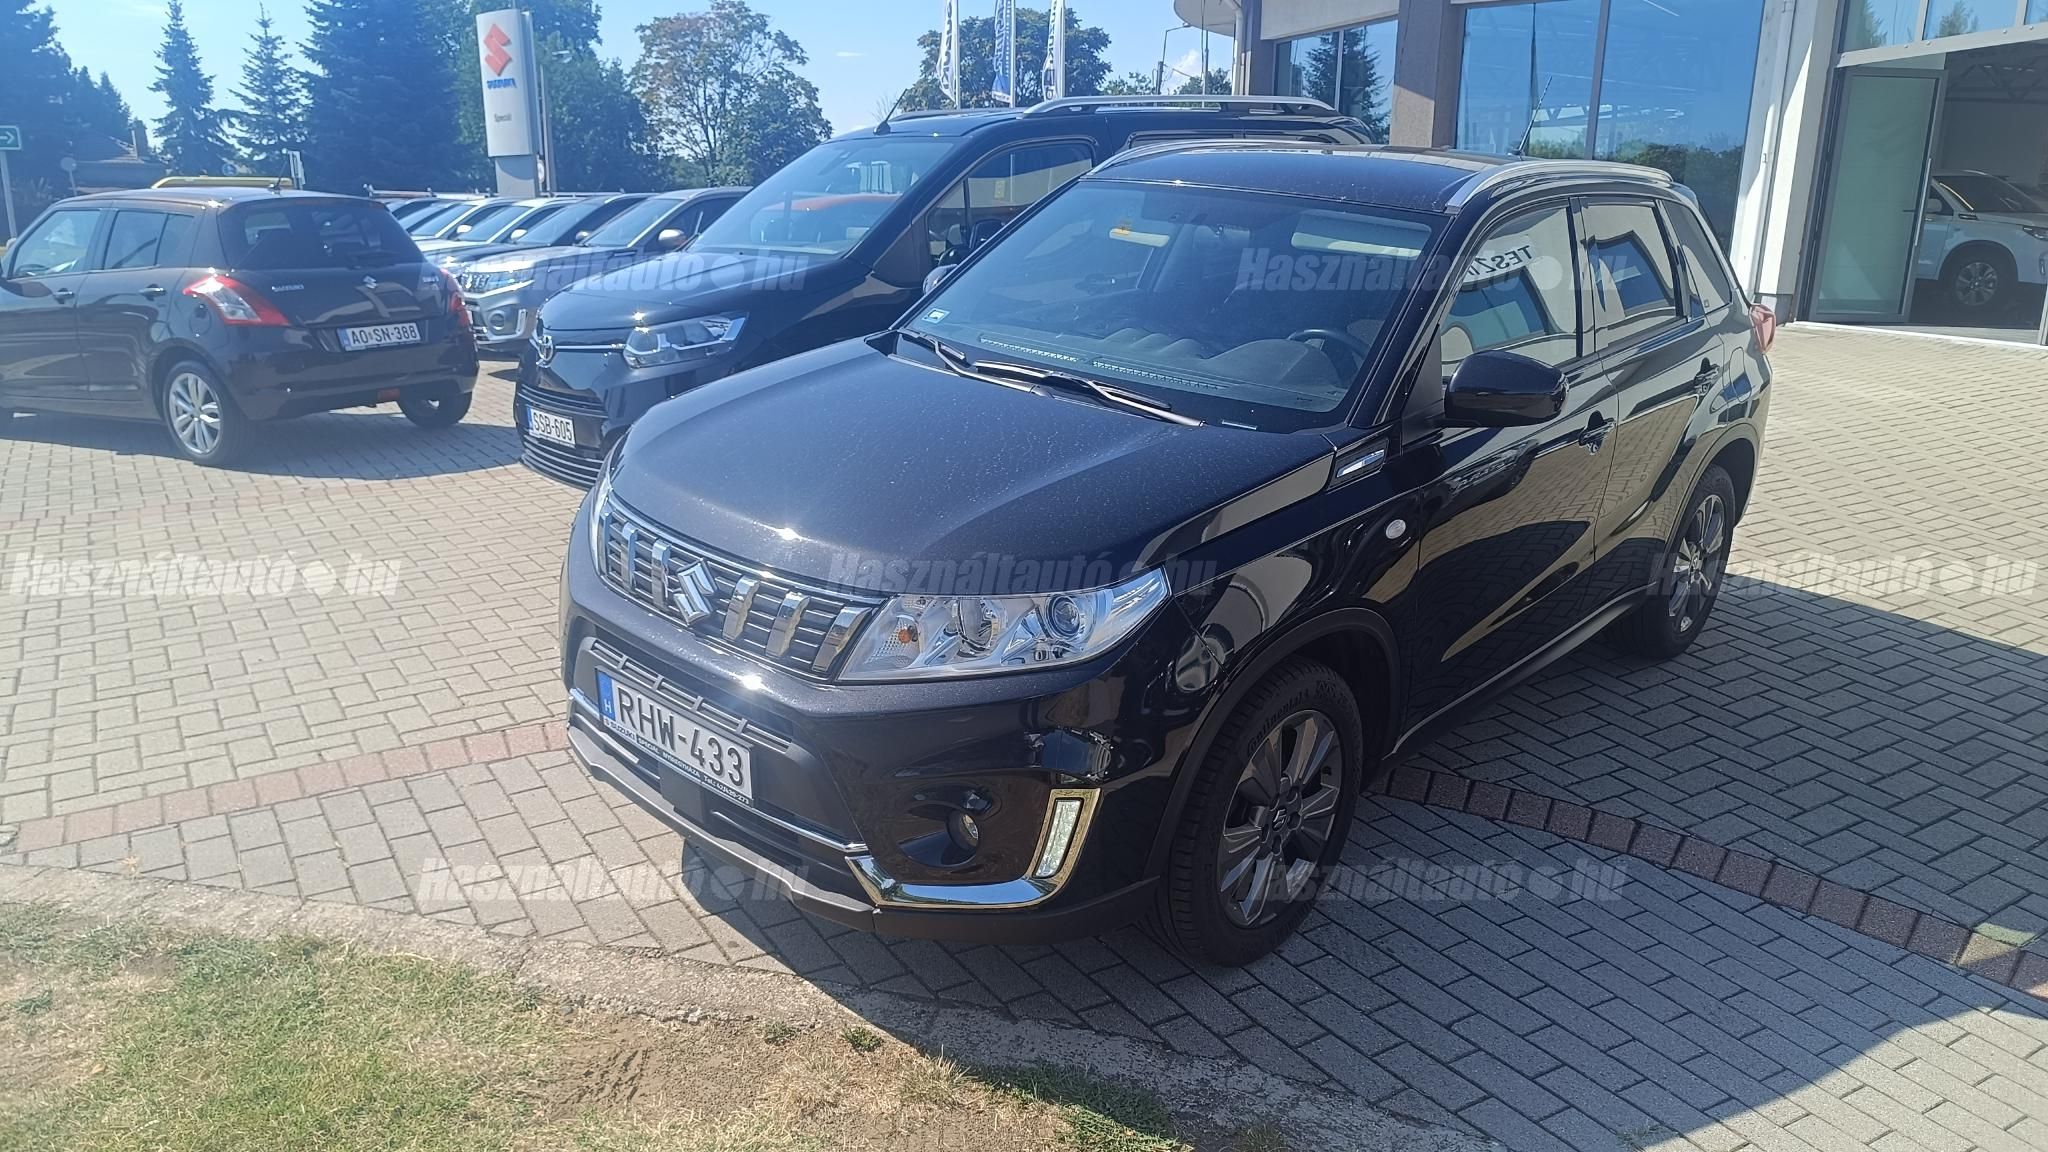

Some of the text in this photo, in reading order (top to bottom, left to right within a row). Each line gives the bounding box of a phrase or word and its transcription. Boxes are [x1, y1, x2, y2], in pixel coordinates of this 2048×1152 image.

[533, 412, 573, 441] SSB-605
[603, 698, 613, 714] H
[617, 686, 746, 788] RHW-433
